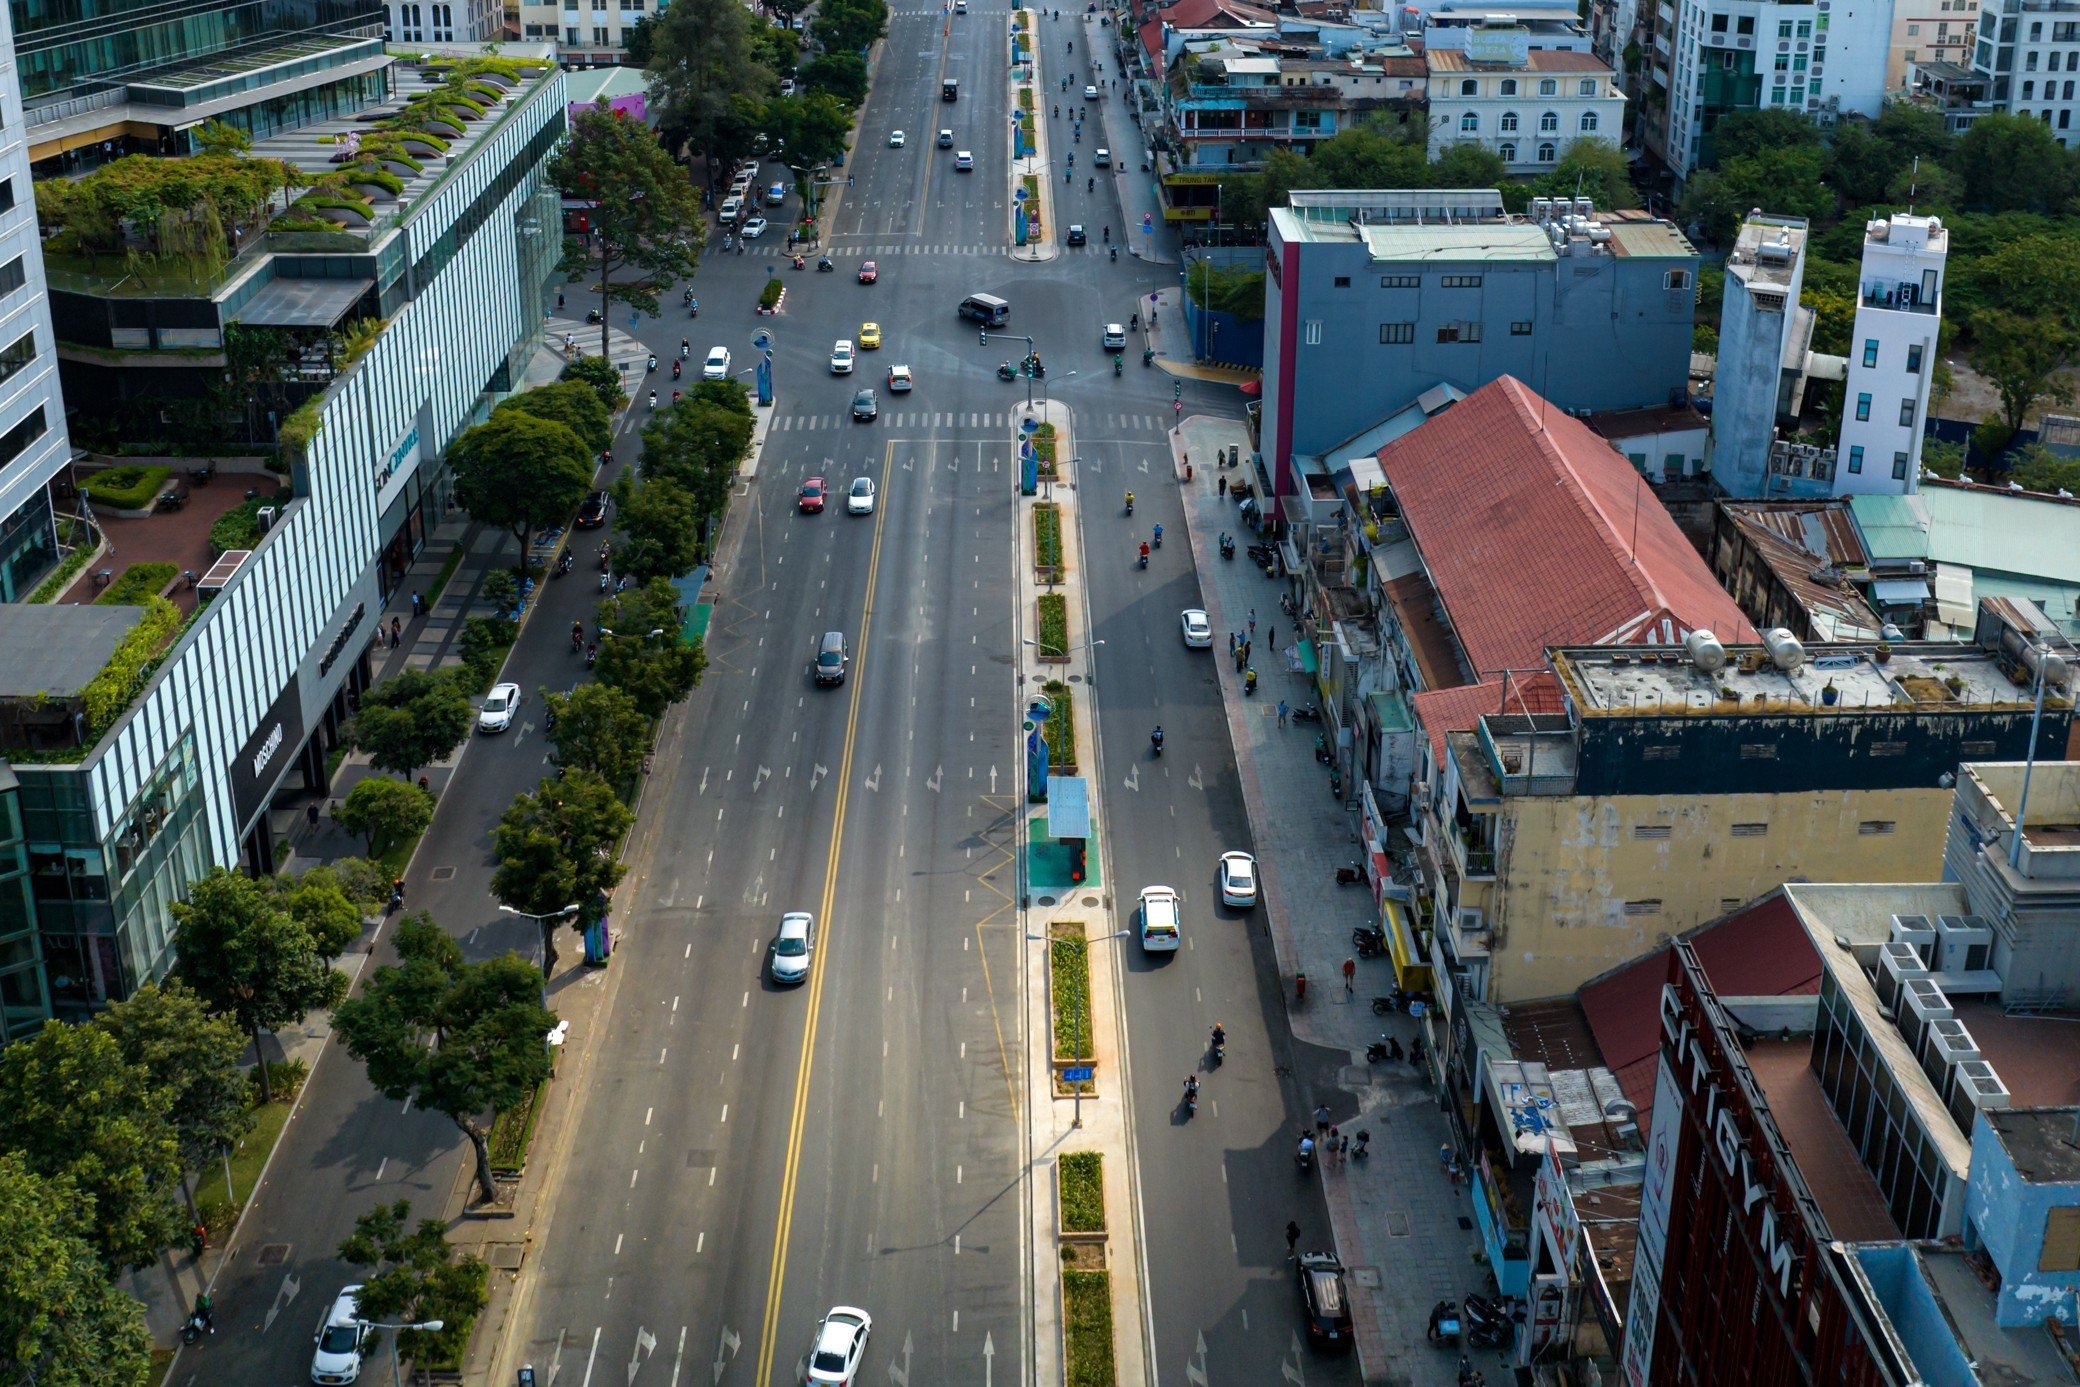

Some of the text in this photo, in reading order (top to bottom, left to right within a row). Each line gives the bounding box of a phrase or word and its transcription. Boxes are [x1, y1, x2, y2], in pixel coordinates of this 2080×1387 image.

[1473, 46, 1507, 54] PIZZA
[253, 722, 283, 778] MOSCHINO
[1661, 983, 1795, 1299] CITIGYM
